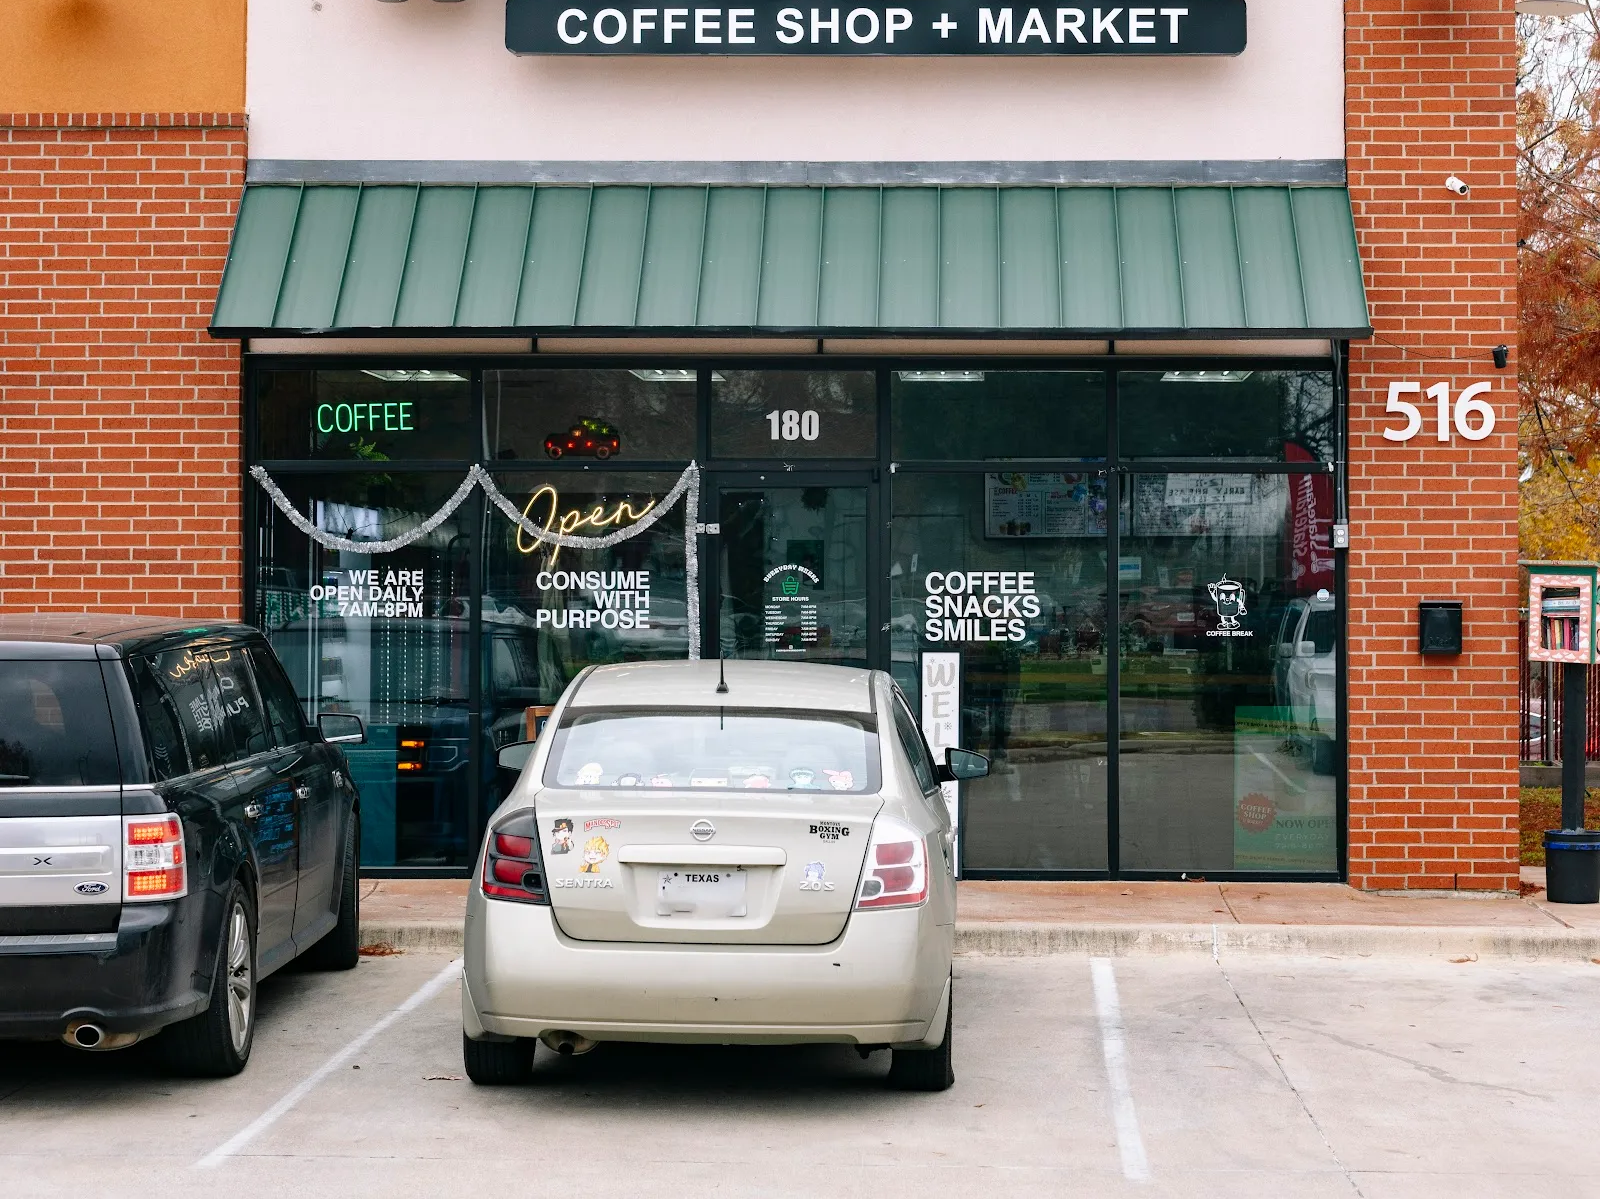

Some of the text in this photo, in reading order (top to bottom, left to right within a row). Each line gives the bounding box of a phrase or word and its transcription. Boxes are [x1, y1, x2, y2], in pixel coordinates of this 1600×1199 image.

[556, 7, 1189, 46] COFFEE SHOP + MARKET
[316, 402, 414, 433] COFFEE
[1381, 380, 1496, 442] 516
[766, 409, 820, 441] 180
[516, 485, 655, 566] Open
[349, 569, 424, 585] WE ARE
[535, 570, 650, 591] CONSUME
[925, 571, 1035, 594] COFFEE
[310, 585, 424, 601] OPEN DAILY
[593, 591, 650, 608] WITH
[338, 602, 423, 617] 7AM-8PM
[925, 595, 1040, 618] SNACKS
[536, 608, 650, 629] PURPOSE
[925, 618, 1026, 641] SMILES
[1240, 804, 1272, 814] COFFEE
[1244, 811, 1267, 820] SHOP
[809, 825, 850, 836] BOXING
[1276, 819, 1305, 828] NOW
[555, 878, 613, 888] SENTRA
[685, 874, 720, 883] TEXAS
